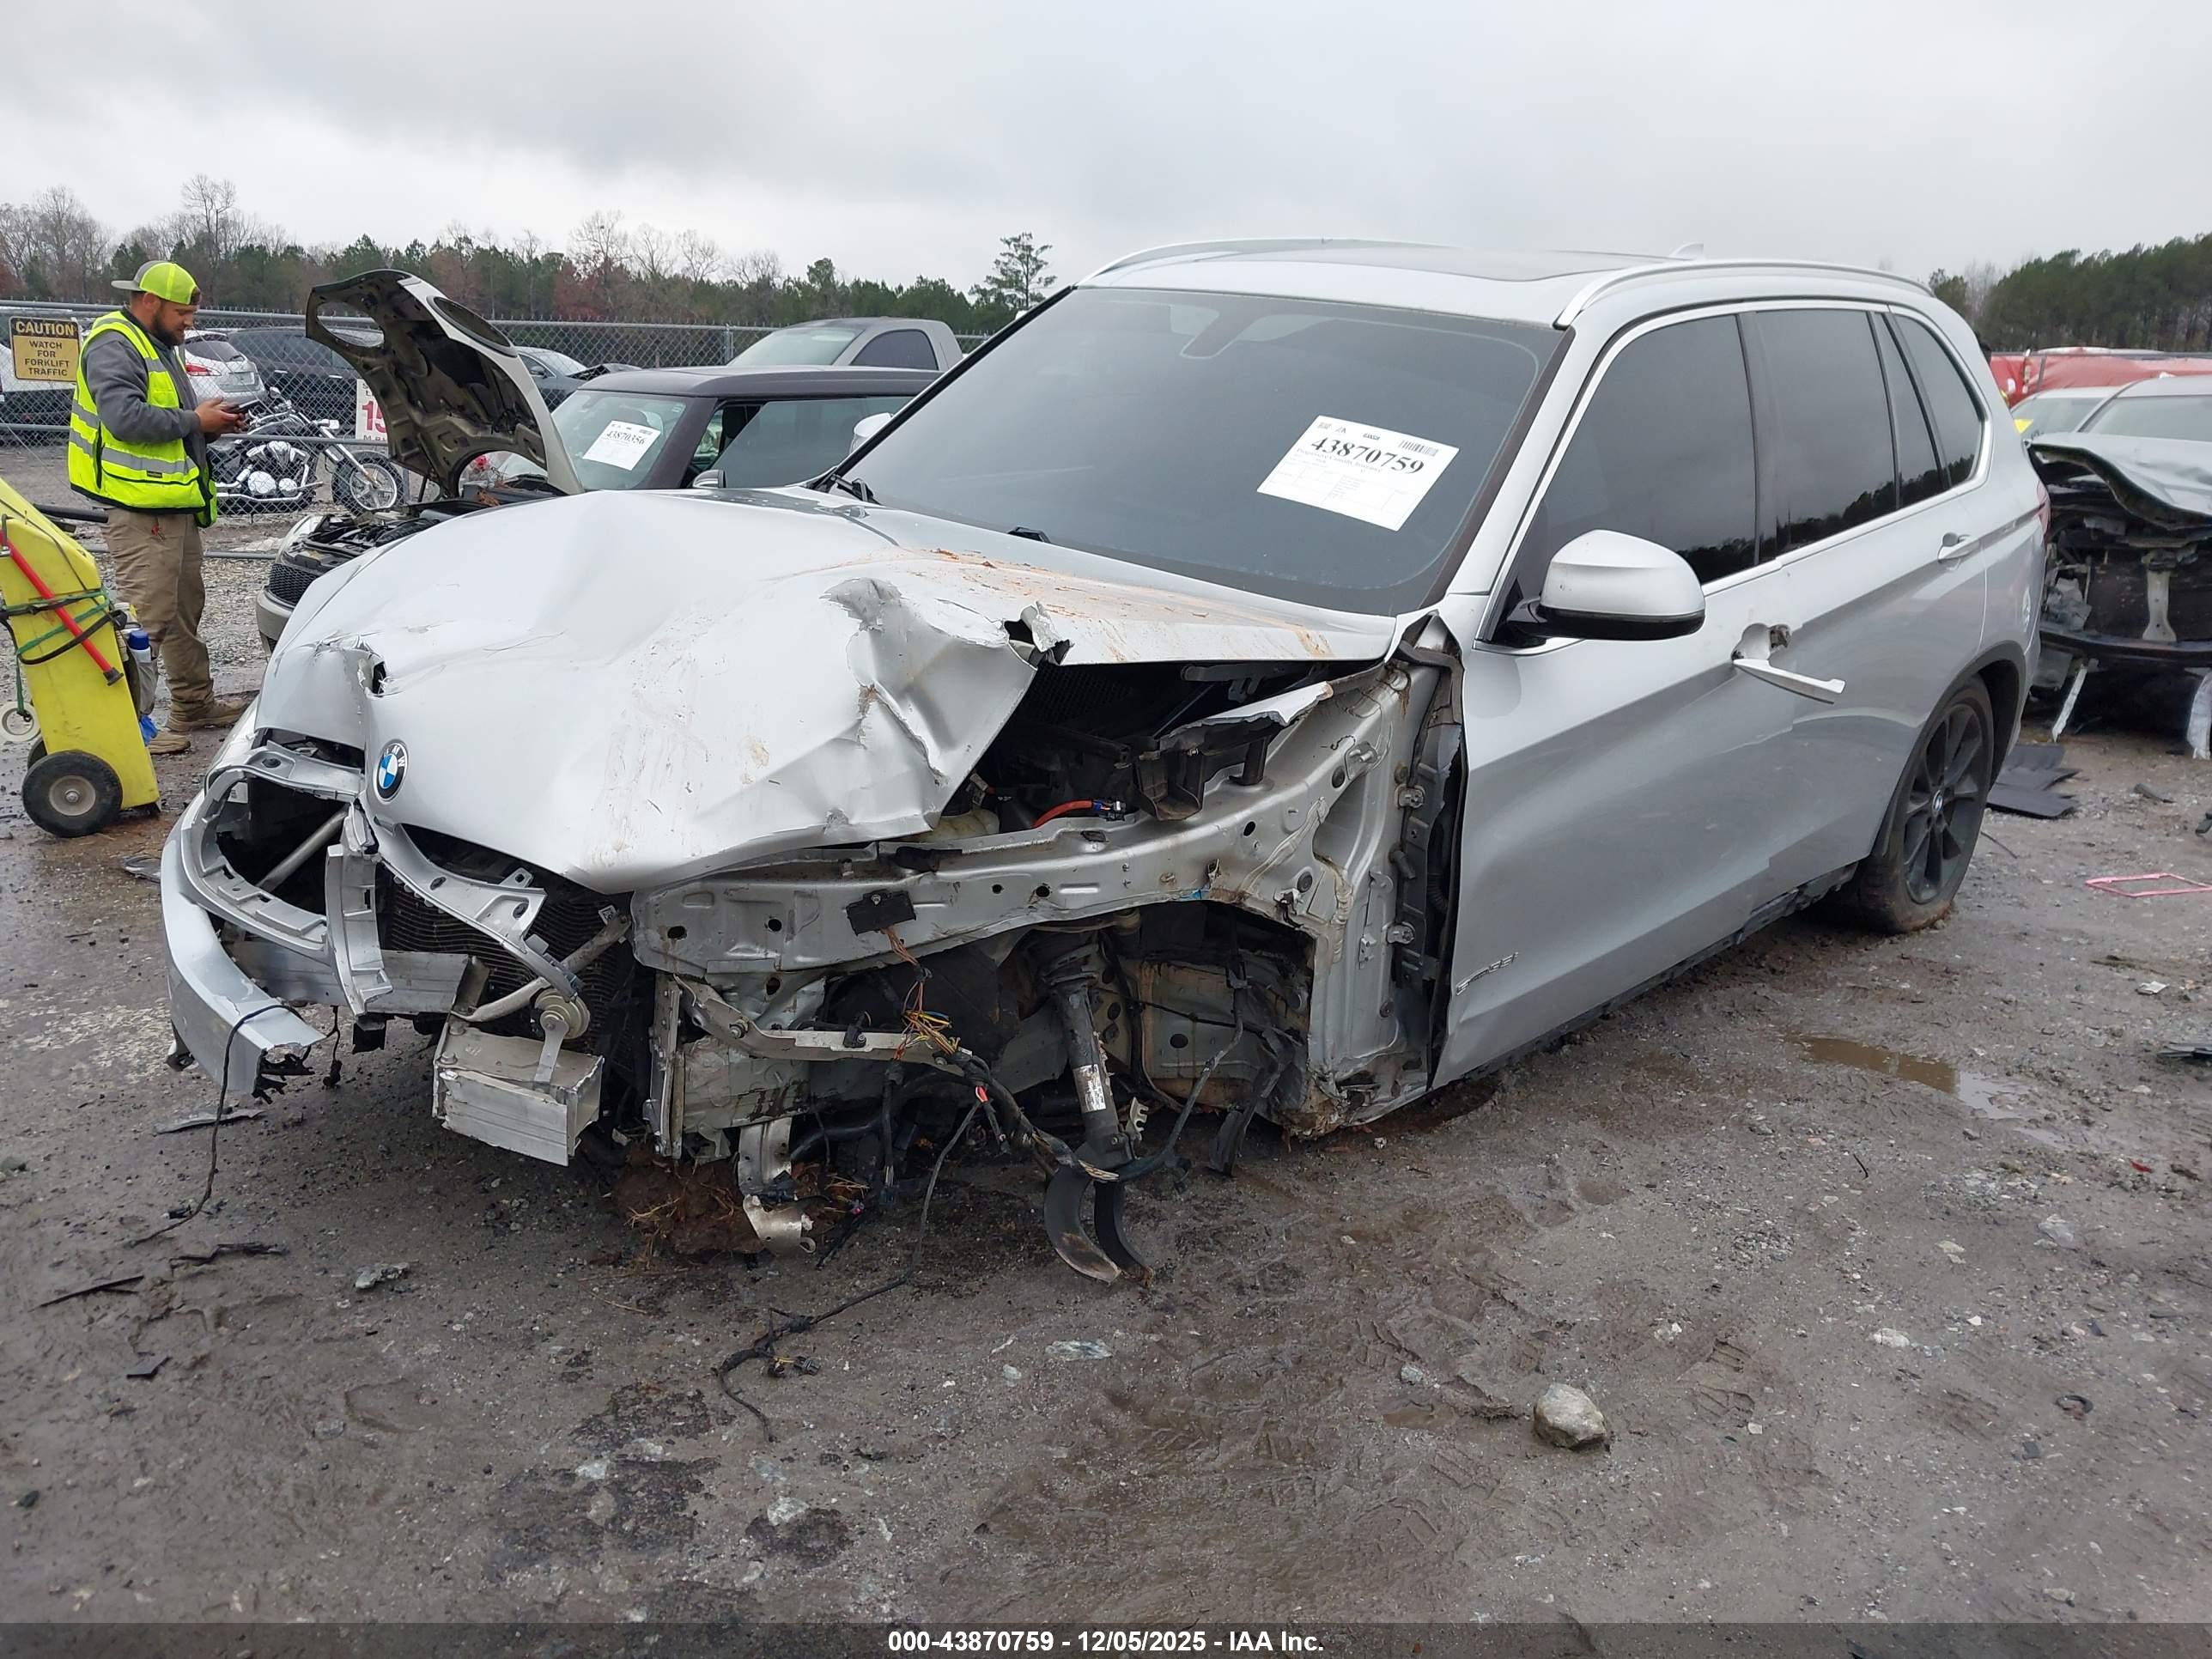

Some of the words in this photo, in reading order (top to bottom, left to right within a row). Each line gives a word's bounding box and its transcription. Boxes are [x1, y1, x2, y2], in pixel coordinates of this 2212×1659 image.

[15, 321, 75, 336] CAUTION
[29, 340, 63, 349] WATCH
[25, 358, 70, 368] FORKLIFT
[28, 368, 68, 376] TRAFFIC
[362, 400, 386, 433] 15
[1310, 437, 1425, 474] 43870759
